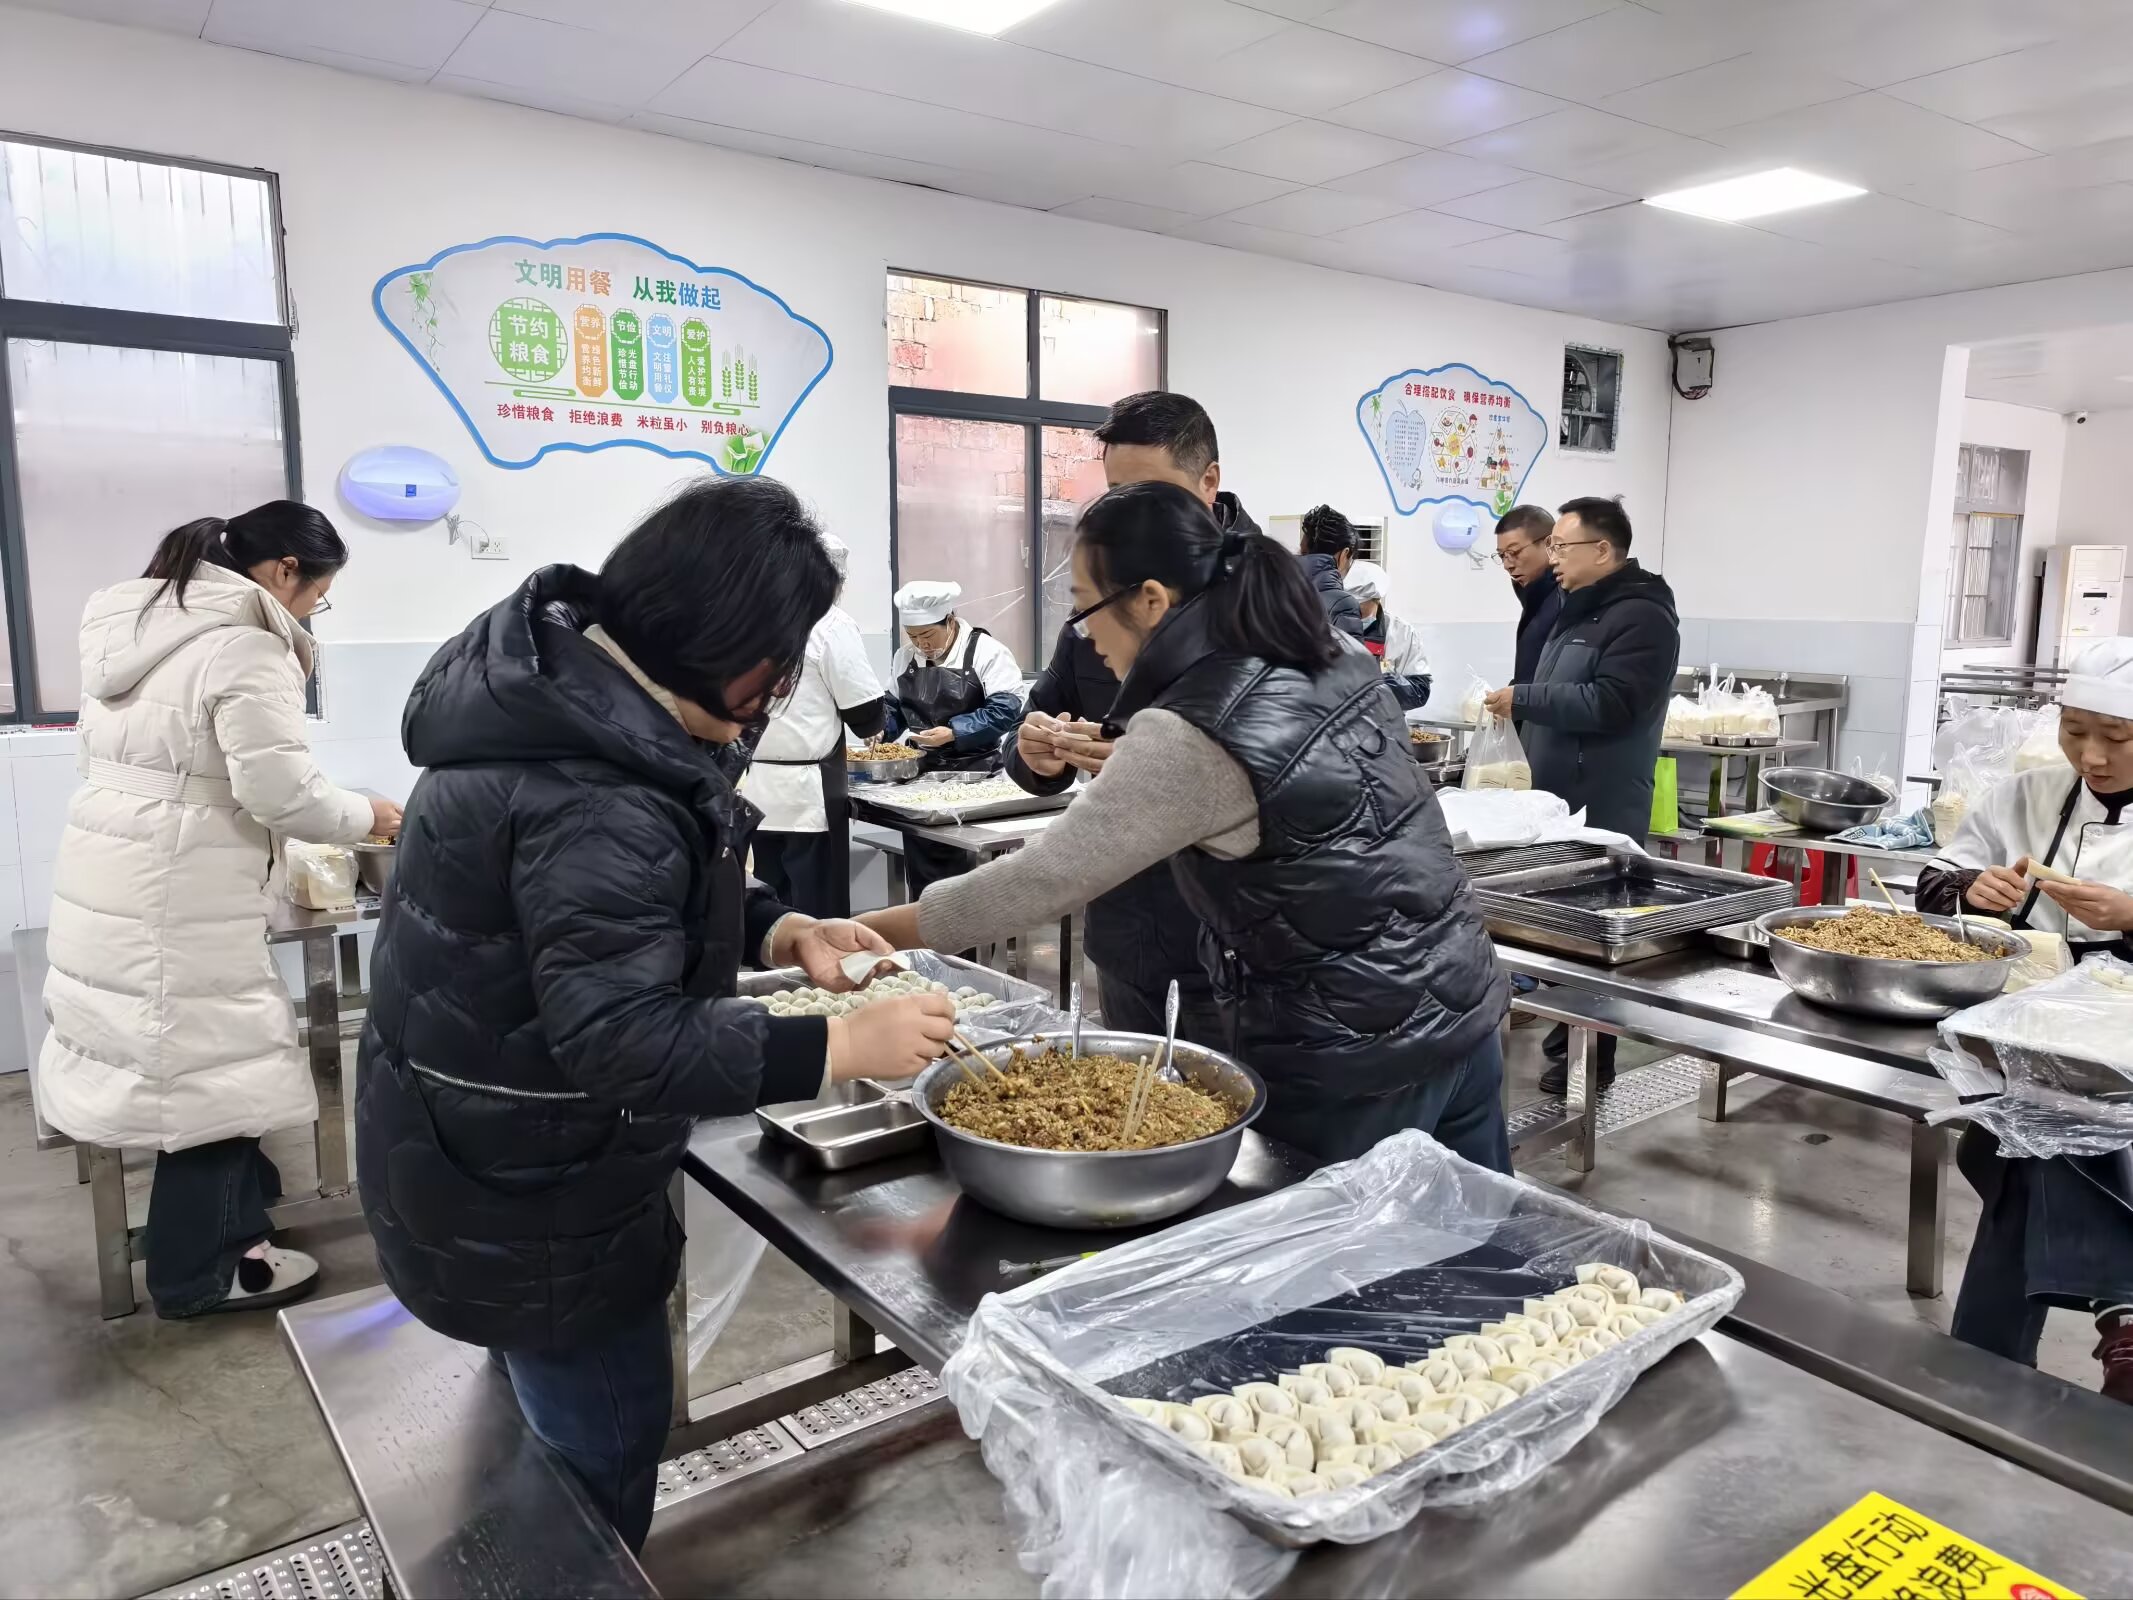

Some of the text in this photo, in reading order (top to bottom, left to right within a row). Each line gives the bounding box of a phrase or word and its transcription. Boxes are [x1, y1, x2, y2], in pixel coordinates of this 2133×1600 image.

[514, 258, 722, 310] 文明用餐 从我做起
[507, 314, 549, 339] 节约
[579, 316, 601, 328] 营养
[616, 320, 637, 333] 节俭
[652, 325, 672, 337] 文明
[686, 328, 706, 341] 爱护
[509, 341, 550, 365] 粮食
[618, 348, 628, 390] 珍惜节俭
[628, 348, 638, 391] 光盘行动
[653, 352, 663, 393] 文明用餐
[687, 355, 697, 396] 人人有责
[697, 356, 707, 397] 爱护环境
[1404, 382, 1456, 401] 合理搭配饮食
[497, 404, 749, 436] 珍惜粮食 拒绝浪费 米粒虽小 别负粮心
[1788, 1512, 1930, 1600] 光盘行动
